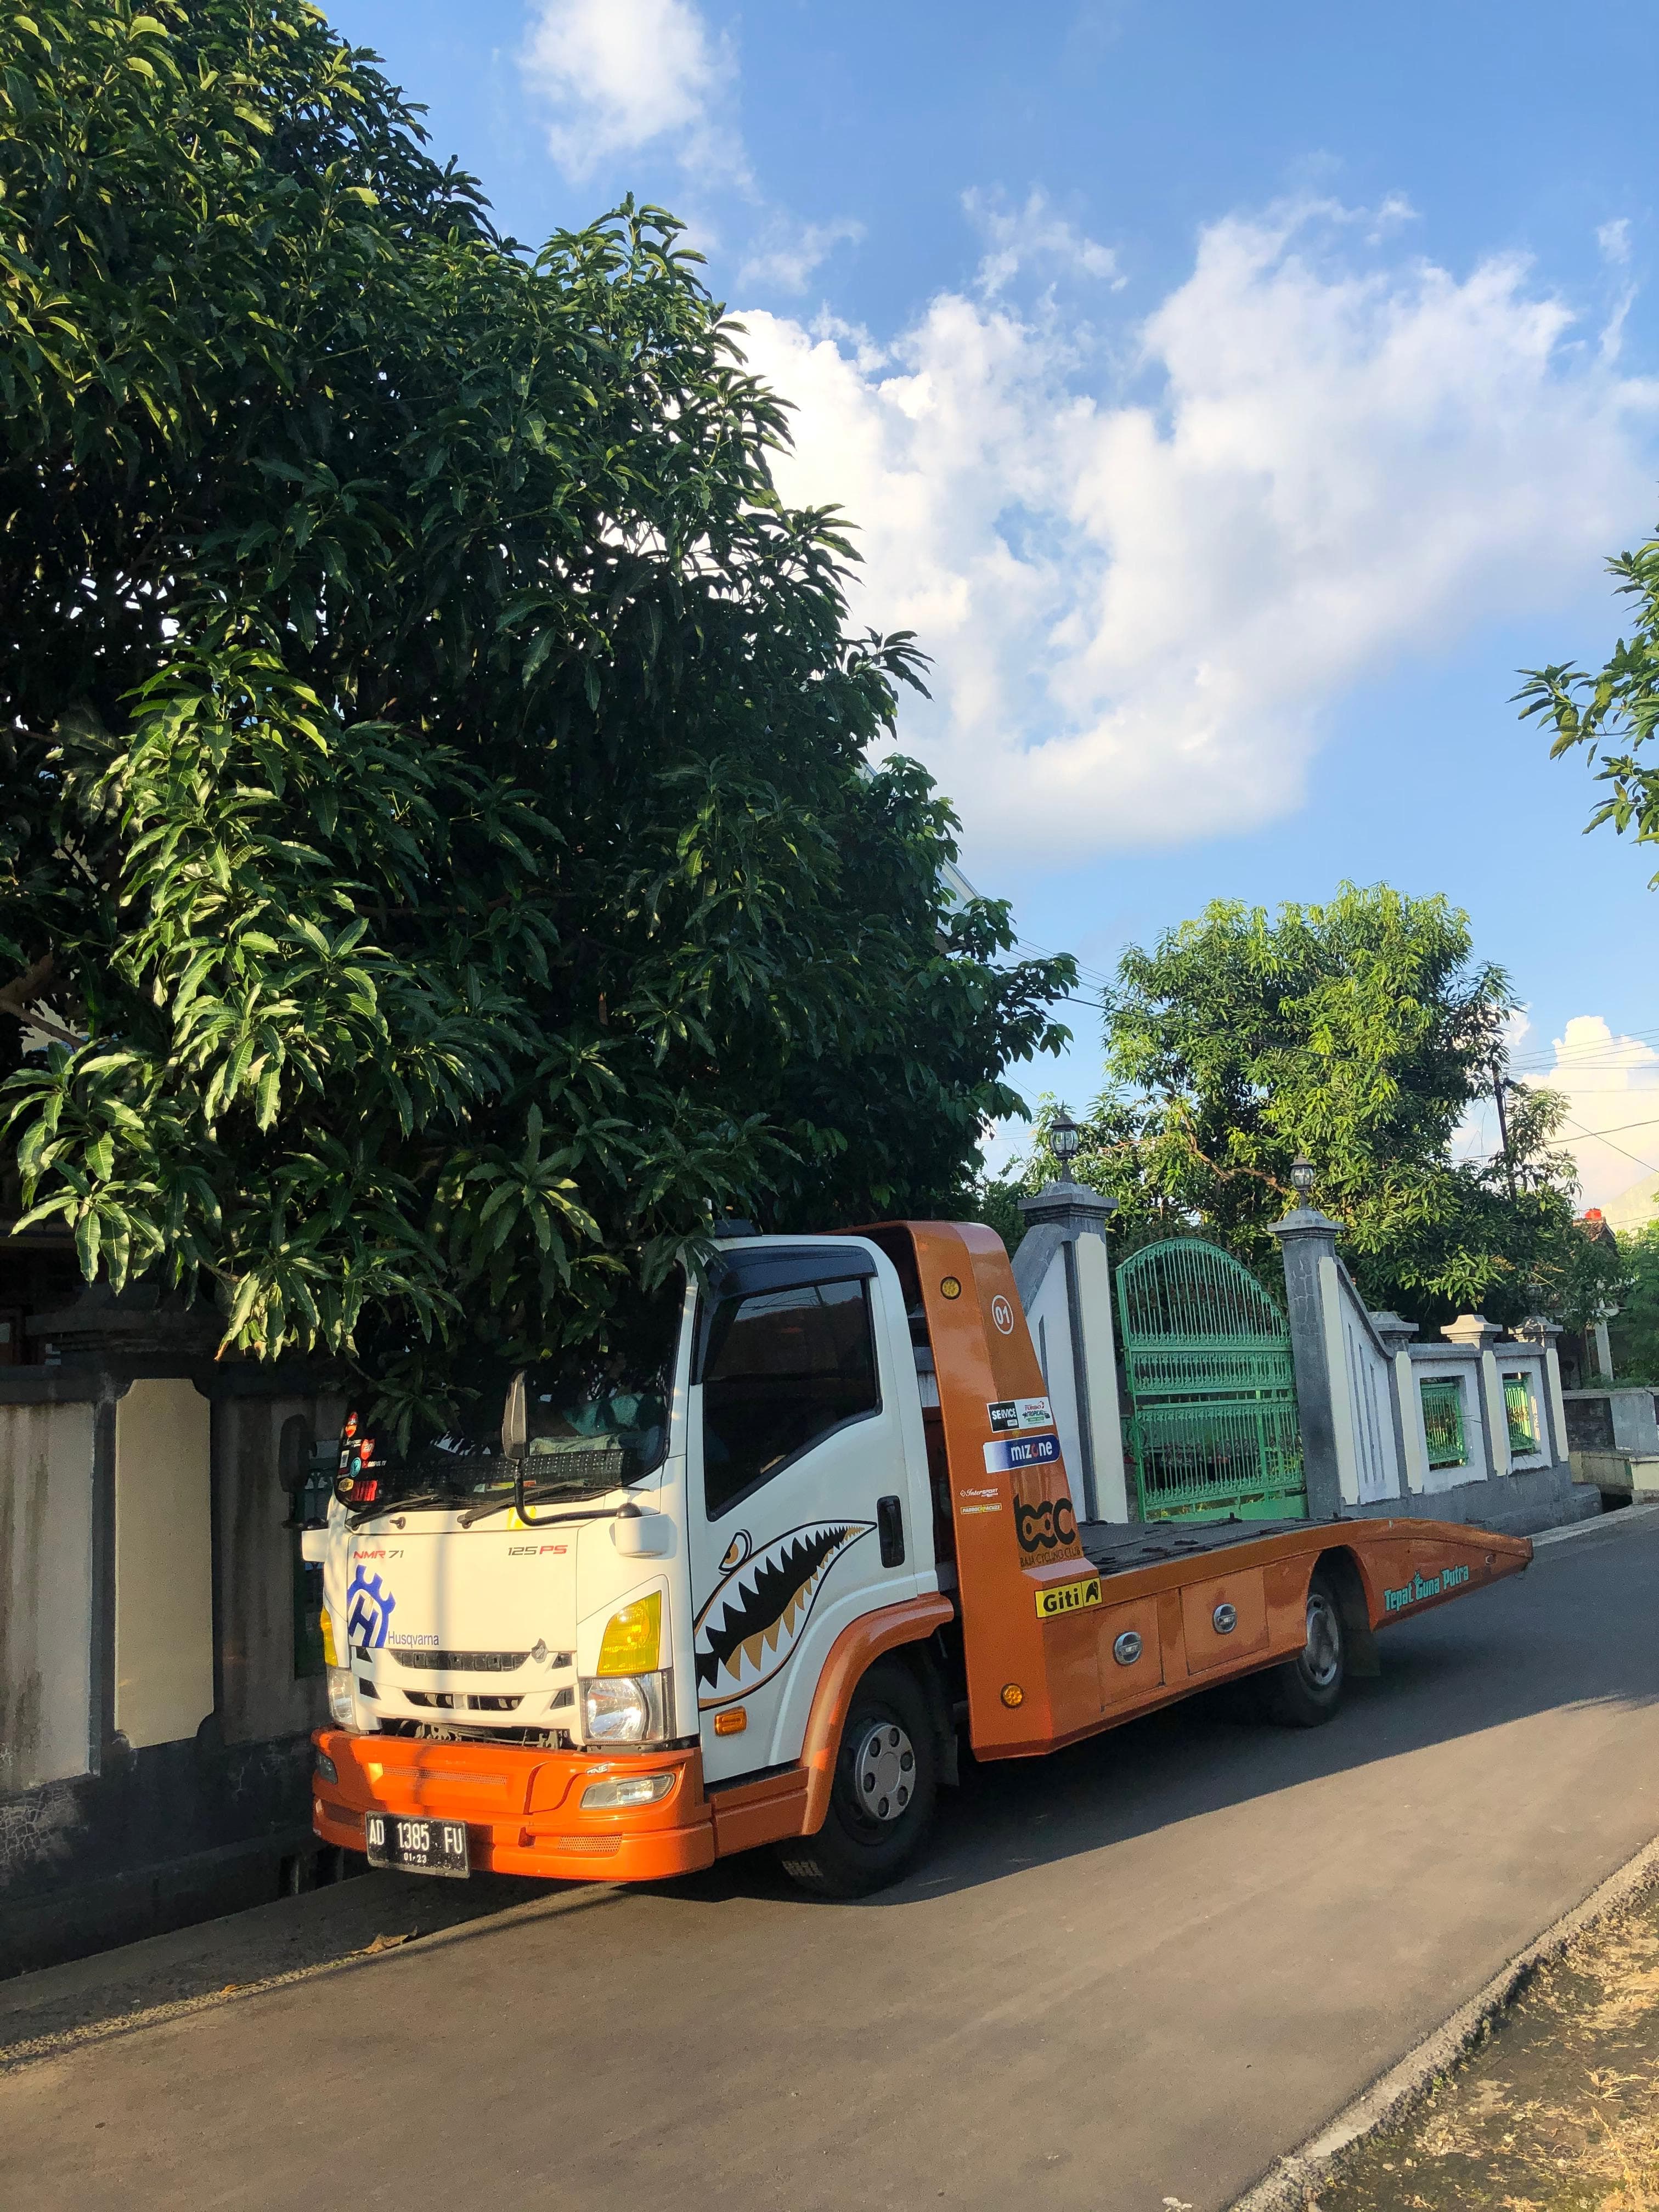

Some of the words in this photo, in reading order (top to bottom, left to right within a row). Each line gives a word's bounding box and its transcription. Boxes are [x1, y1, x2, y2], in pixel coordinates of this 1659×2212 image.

[995, 1305, 1010, 1324] 01
[991, 1408, 1017, 1420] SERVICE
[1011, 1441, 1053, 1462] mizone
[353, 1550, 386, 1559] NMR
[388, 1550, 404, 1558] 71
[507, 1546, 538, 1556] 125
[539, 1544, 568, 1555] PS
[1020, 1557, 1036, 1567] BAJA
[1064, 1545, 1081, 1557] CLUB
[1384, 1582, 1414, 1612] Tepat
[1414, 1575, 1441, 1600] Guna
[1441, 1565, 1469, 1590] Putra
[1043, 1588, 1079, 1612] Giti
[388, 1630, 439, 1648] Husqvarna
[369, 1818, 385, 1846] AD
[397, 1822, 430, 1852] 1385
[444, 1826, 462, 1854] FU
